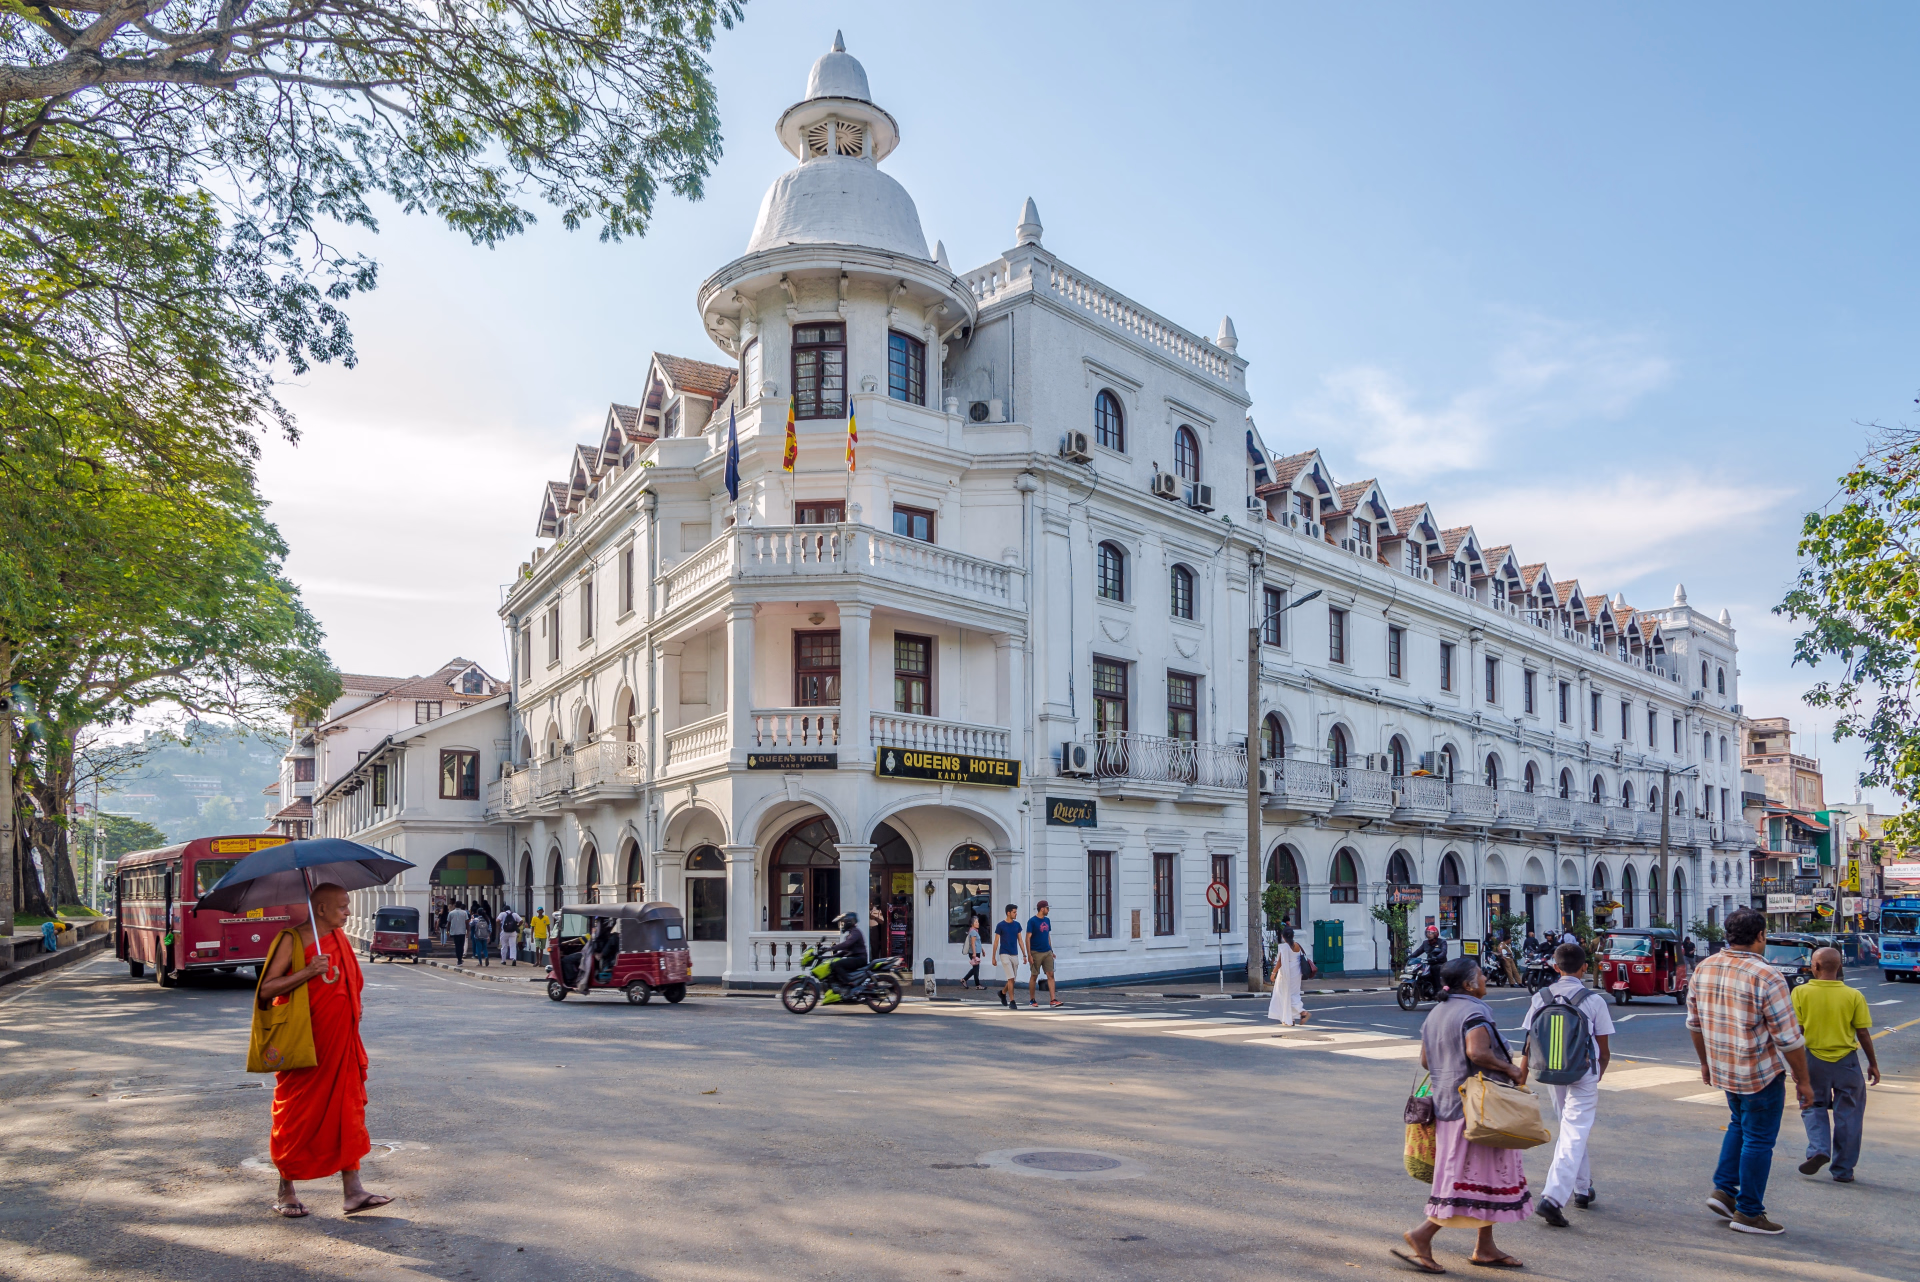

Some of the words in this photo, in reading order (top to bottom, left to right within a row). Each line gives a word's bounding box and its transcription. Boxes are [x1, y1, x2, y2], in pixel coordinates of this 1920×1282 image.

[758, 754, 796, 763] QUEEN'S
[800, 755, 829, 763] HOTEL
[903, 752, 960, 771] QUEEN'S
[969, 759, 1013, 776] HOTEL
[938, 771, 969, 781] KANDY
[1052, 802, 1092, 824] Queen's
[1849, 860, 1858, 884] TAXI
